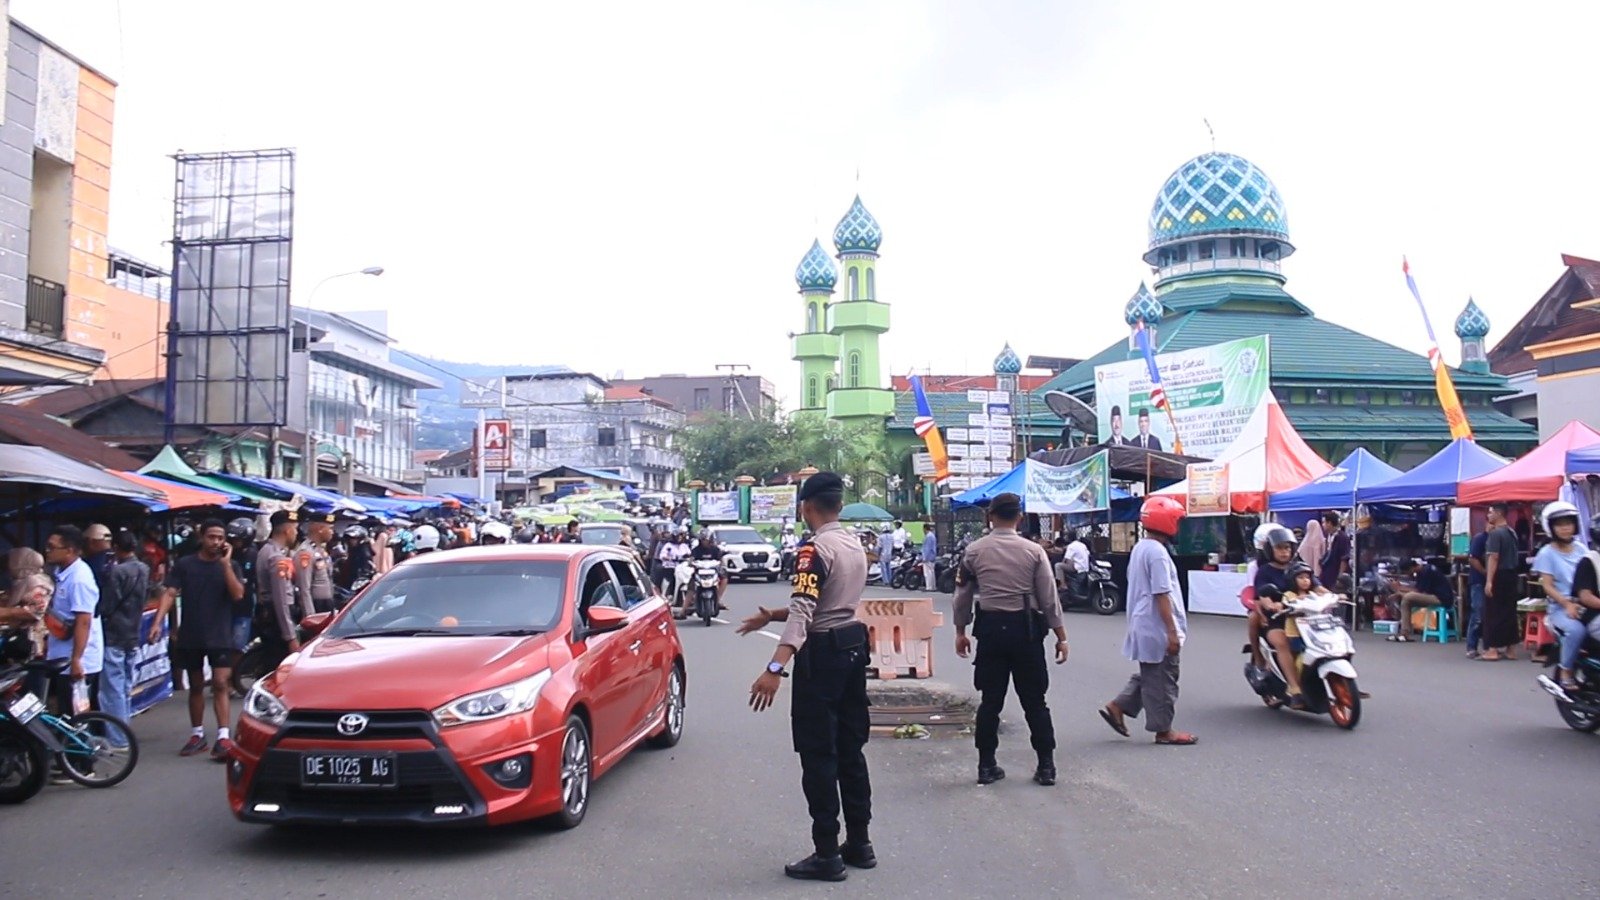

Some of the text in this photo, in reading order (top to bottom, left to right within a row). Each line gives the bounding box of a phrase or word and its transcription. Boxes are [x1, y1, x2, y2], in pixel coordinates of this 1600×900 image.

[306, 757, 389, 776] DE 1025 AG
